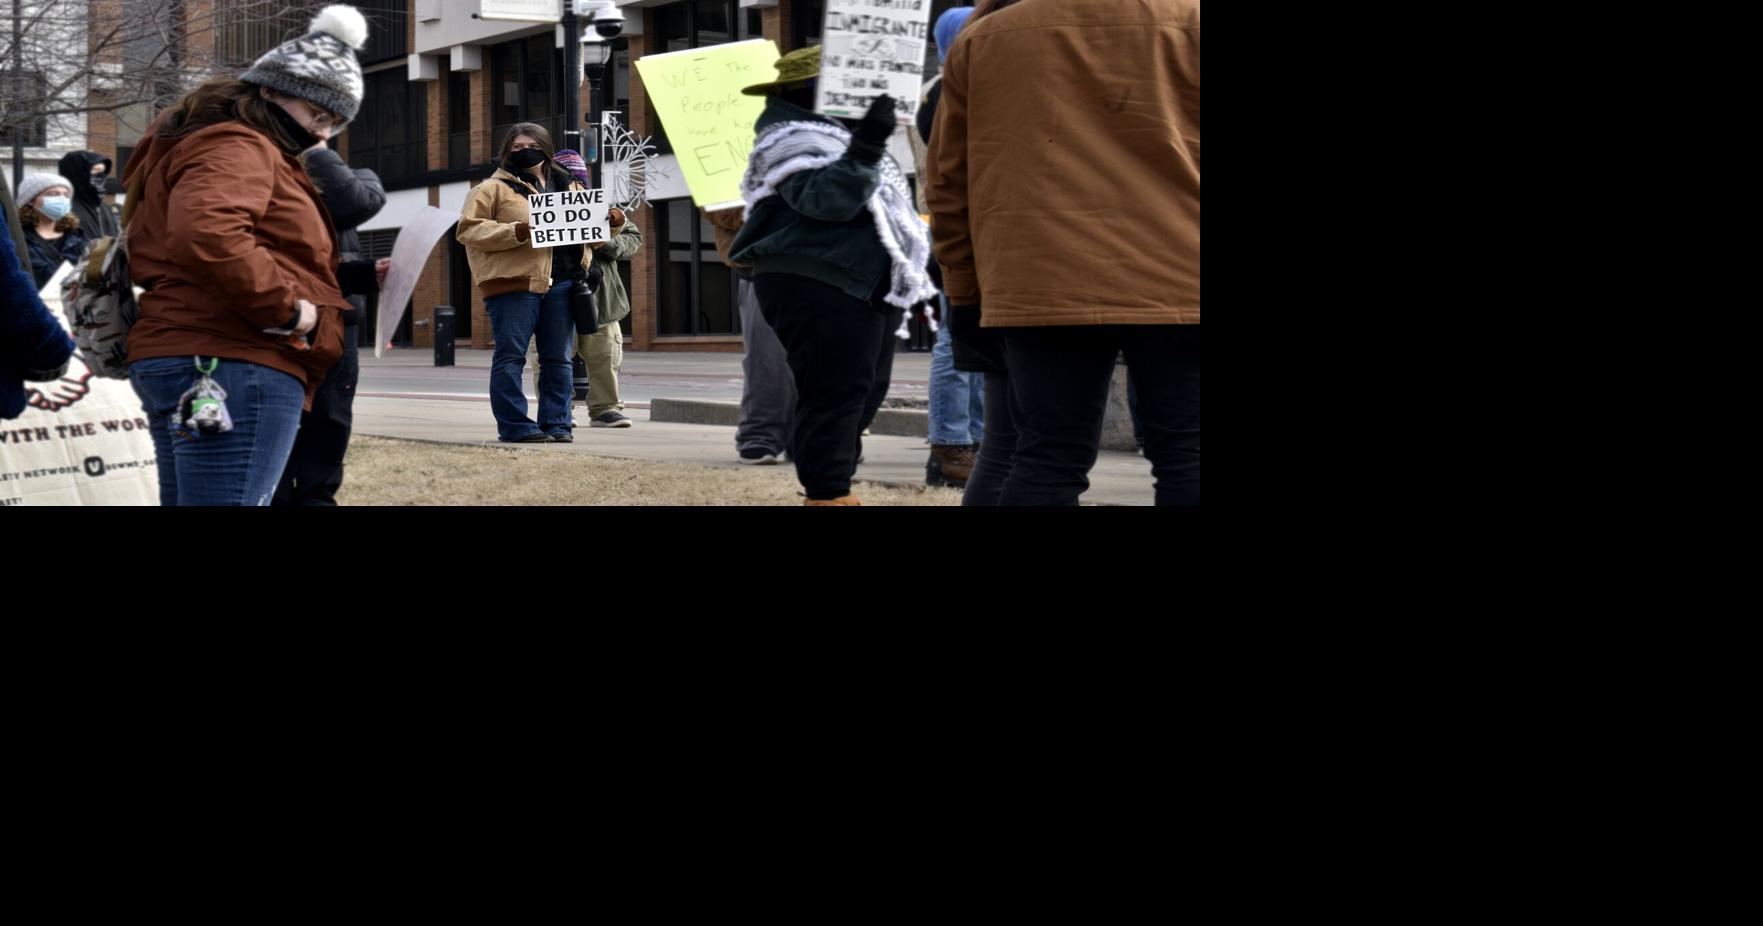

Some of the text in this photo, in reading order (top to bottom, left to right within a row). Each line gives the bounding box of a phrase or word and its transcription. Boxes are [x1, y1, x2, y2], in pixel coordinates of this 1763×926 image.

[681, 93, 743, 116] People
[530, 190, 604, 208] WE HAVE
[531, 208, 591, 226] TO DO
[534, 226, 603, 244] BETTER
[55, 422, 97, 439] THE
[101, 417, 149, 433] WOR
[24, 465, 81, 479] NETWORK
